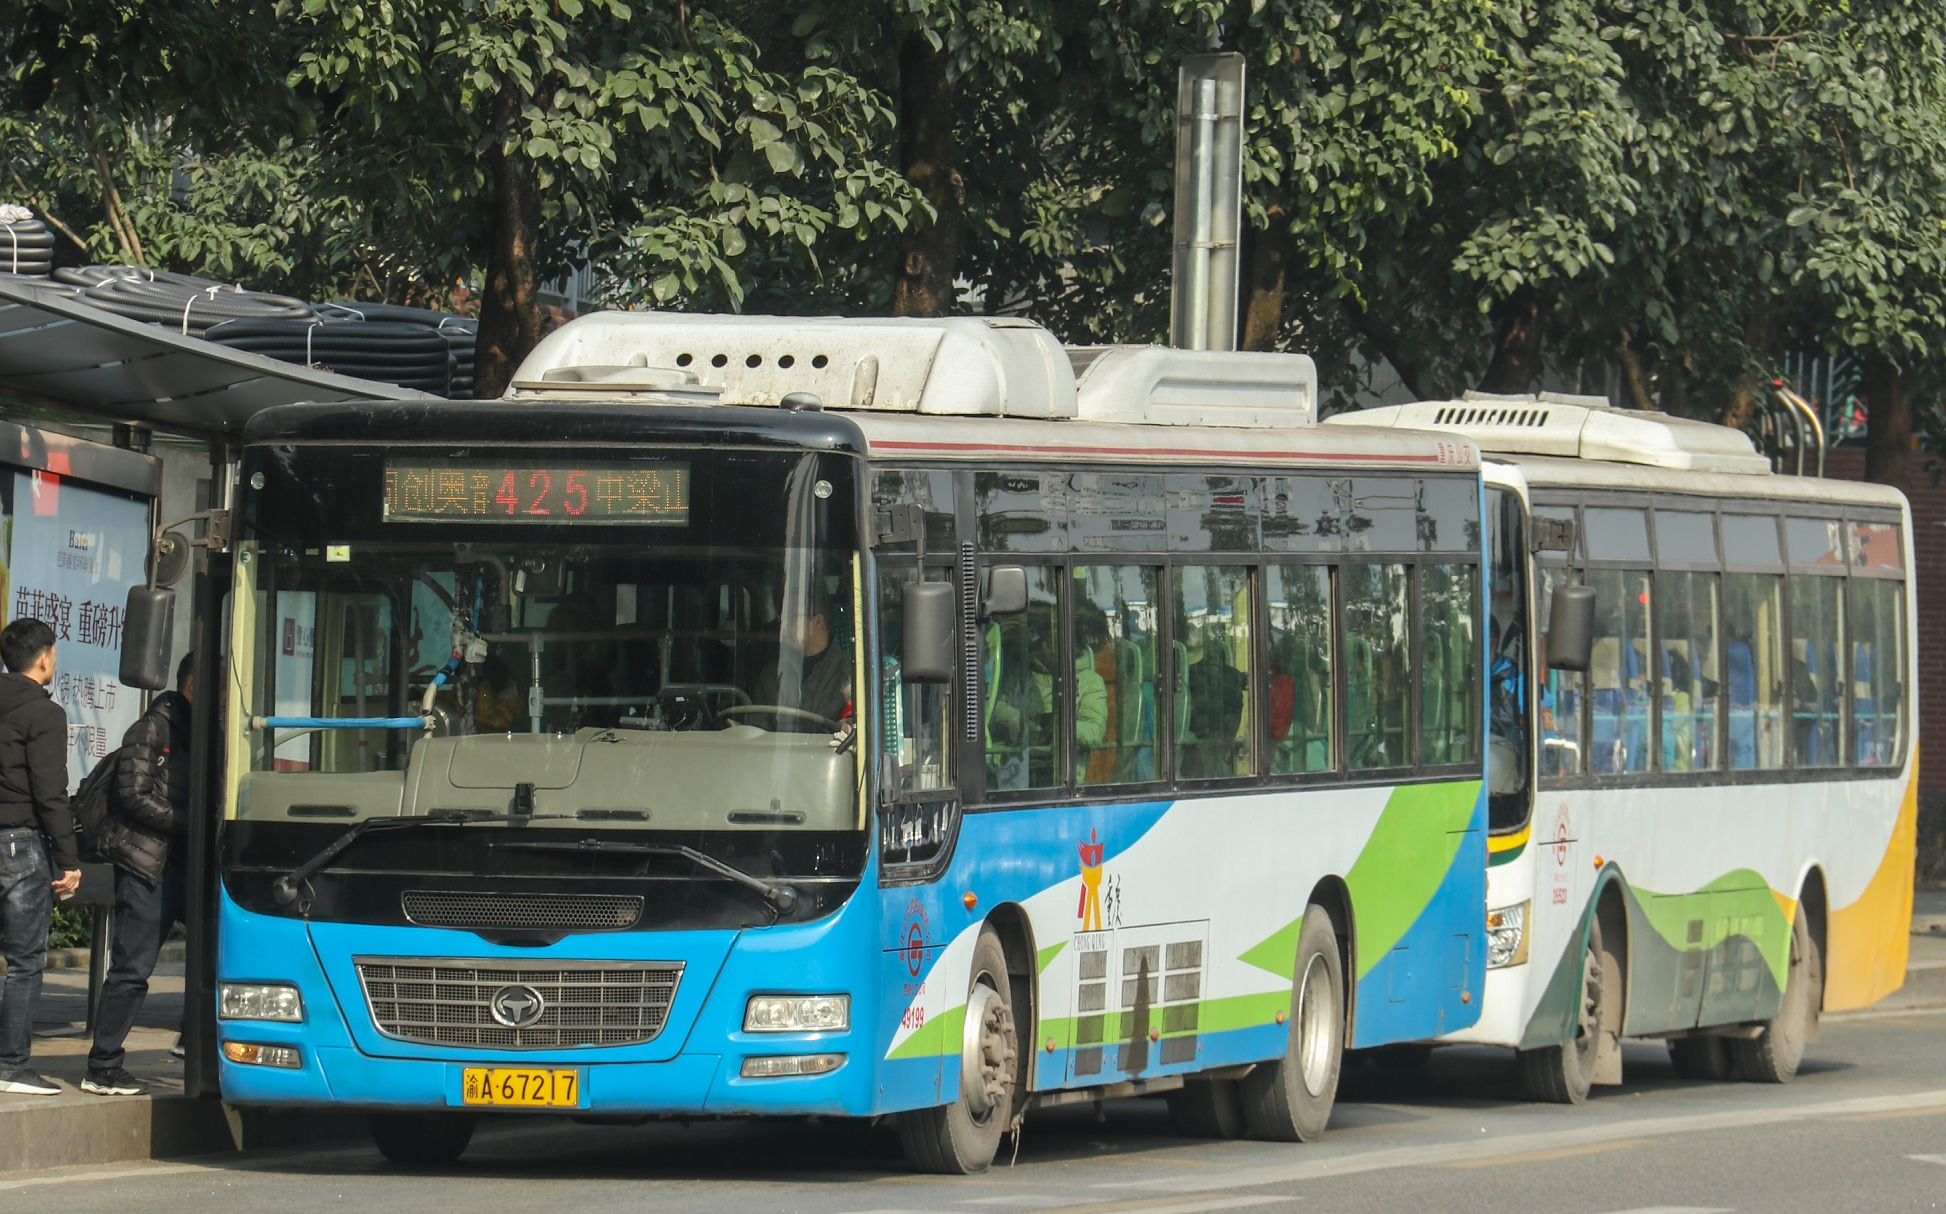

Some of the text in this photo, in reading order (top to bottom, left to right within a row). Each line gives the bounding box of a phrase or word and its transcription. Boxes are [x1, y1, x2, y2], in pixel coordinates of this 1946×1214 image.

[495, 470, 587, 515] 425
[77, 600, 126, 651] 重磅升
[902, 1006, 924, 1030] 49199
